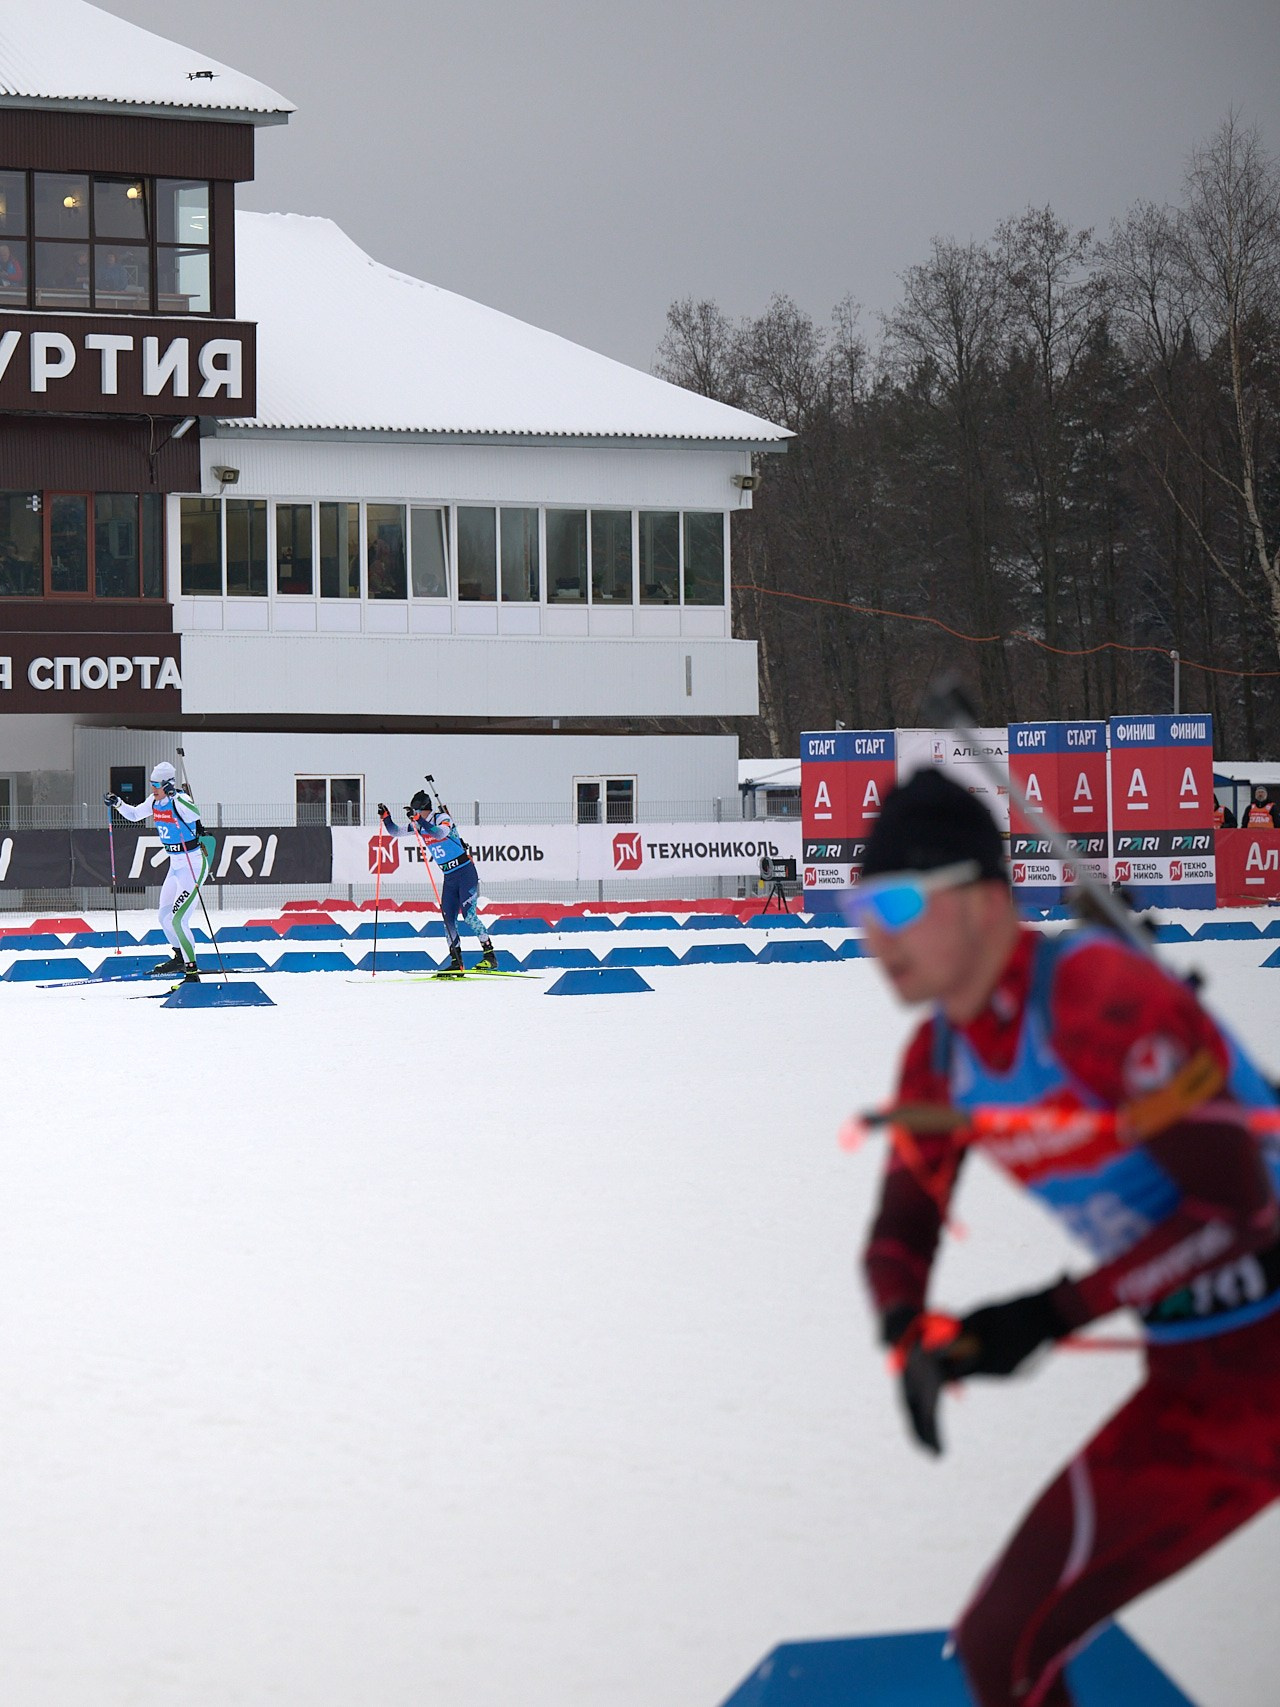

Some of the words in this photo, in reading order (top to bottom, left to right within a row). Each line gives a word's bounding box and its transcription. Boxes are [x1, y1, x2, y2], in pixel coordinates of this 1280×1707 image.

[26, 657, 182, 691] СПОРТА
[1067, 729, 1097, 746] СТАРТ
[1117, 723, 1156, 741] ФИНИШ
[1171, 722, 1206, 740] ФИНИШ
[855, 738, 885, 754] СТАРТ
[1017, 731, 1047, 747] СТАРТ
[809, 740, 835, 755] СТАРТ
[157, 825, 171, 839] 52
[646, 841, 779, 859] ТЕХНОНИКОЛЬ
[1015, 840, 1053, 853] PARI
[1117, 836, 1160, 851] PARI
[1172, 836, 1210, 850] PARI
[431, 845, 446, 859] 25
[806, 844, 842, 858] PARI
[1132, 863, 1157, 871] ТЕХНО
[1183, 862, 1207, 870] ТЕХНО
[818, 876, 845, 884] НИКОЛЬ
[1028, 873, 1057, 881] НИКОЛЬ
[1133, 872, 1164, 880] НИКОЛЬ
[1184, 870, 1214, 879] НИКОЛЬ
